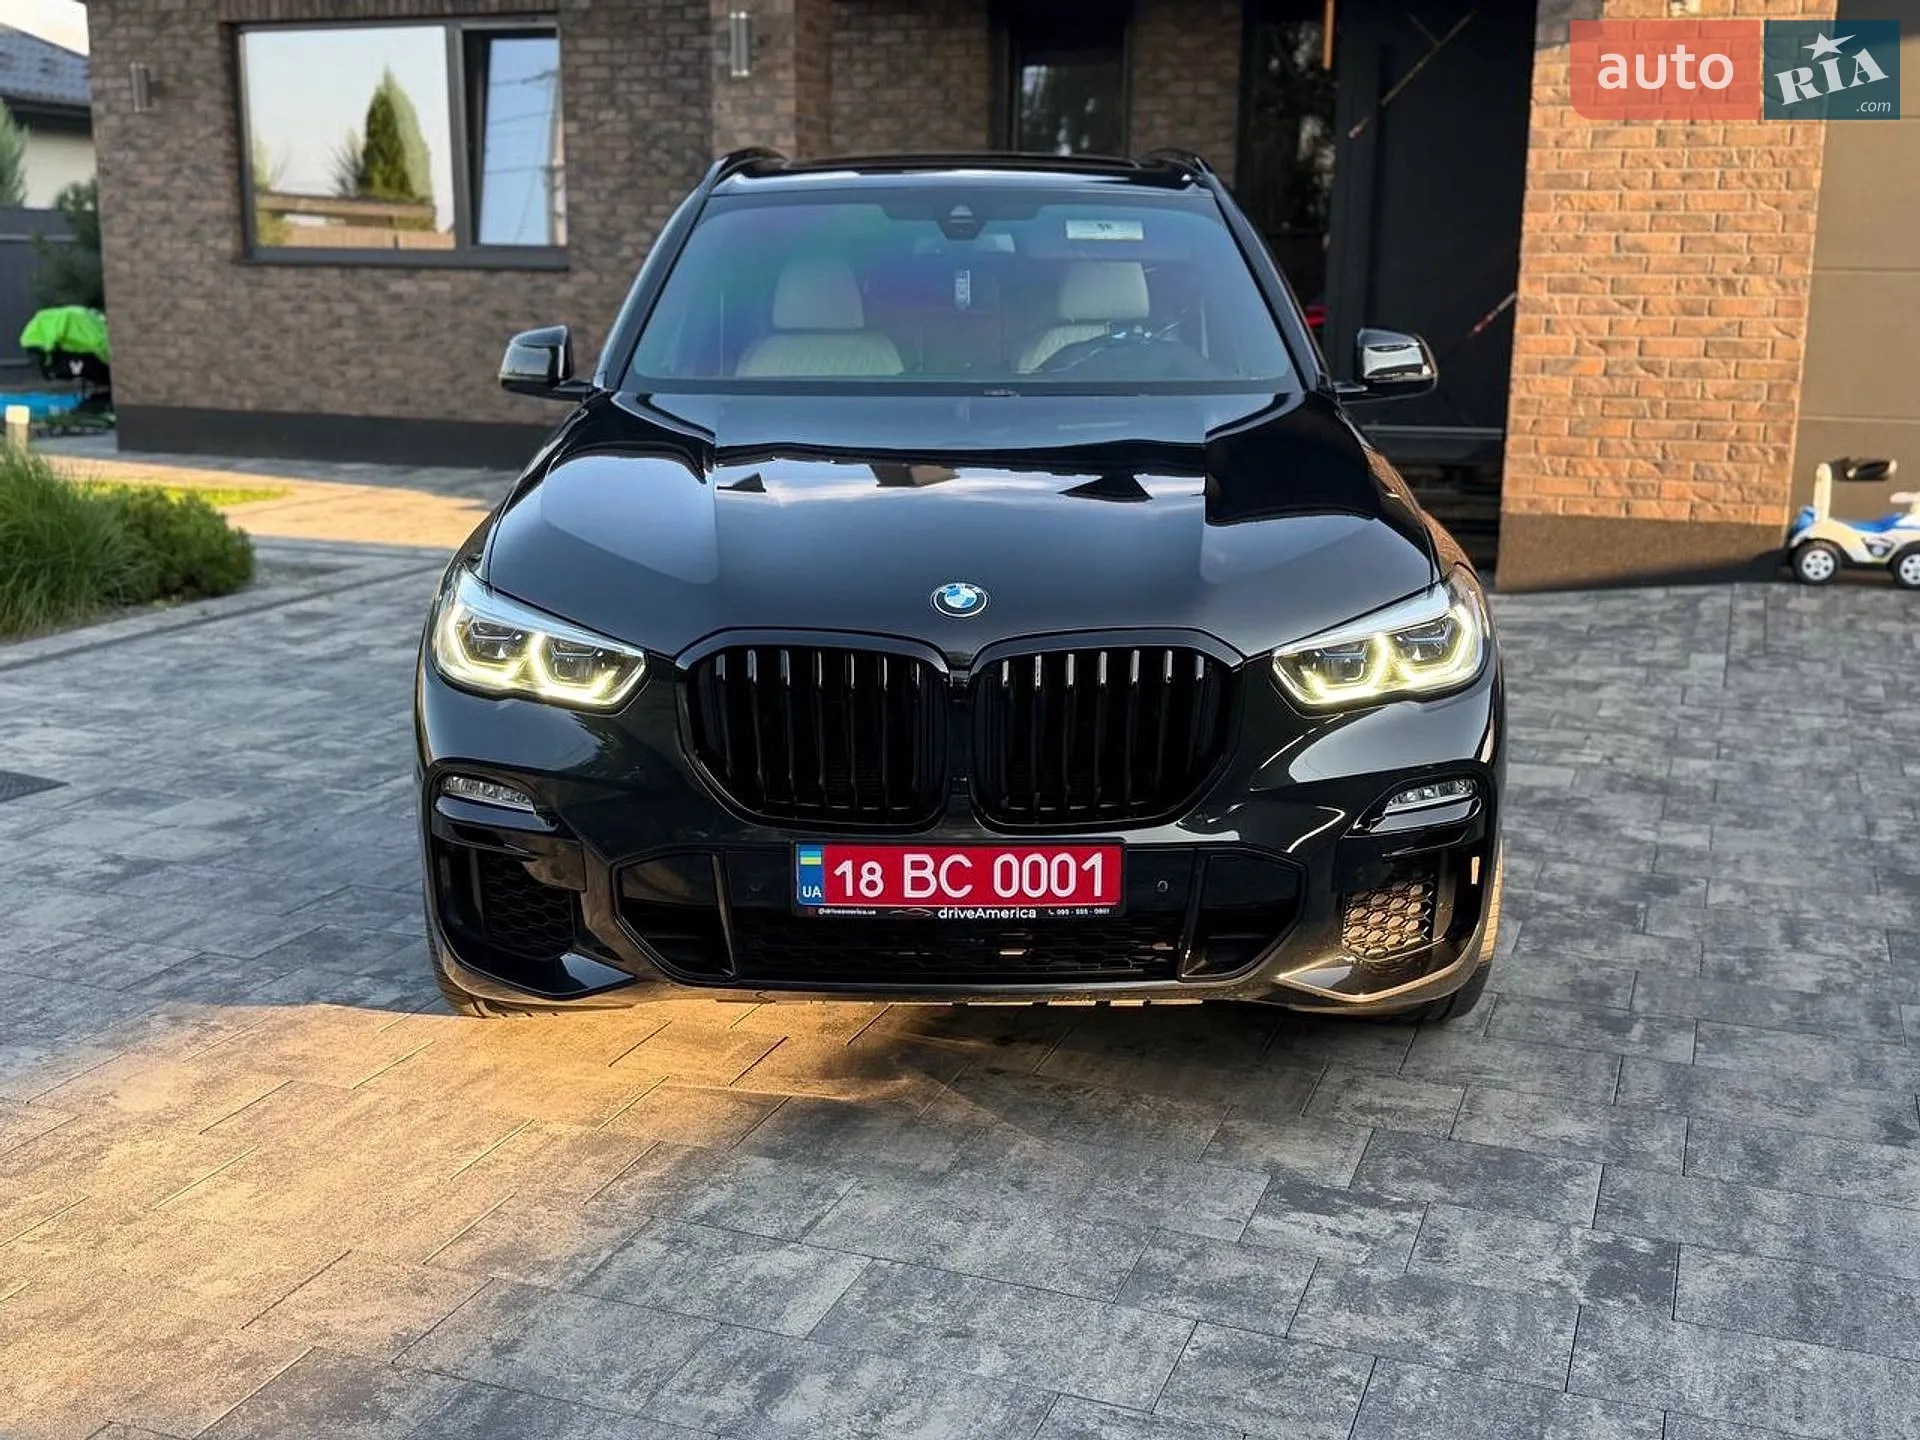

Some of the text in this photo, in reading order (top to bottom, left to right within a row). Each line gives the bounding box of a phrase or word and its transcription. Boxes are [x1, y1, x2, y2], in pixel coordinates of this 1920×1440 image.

[833, 853, 1103, 898] 18 BC 0001
[802, 886, 822, 898] UA
[938, 907, 1037, 919] driveAmerica
